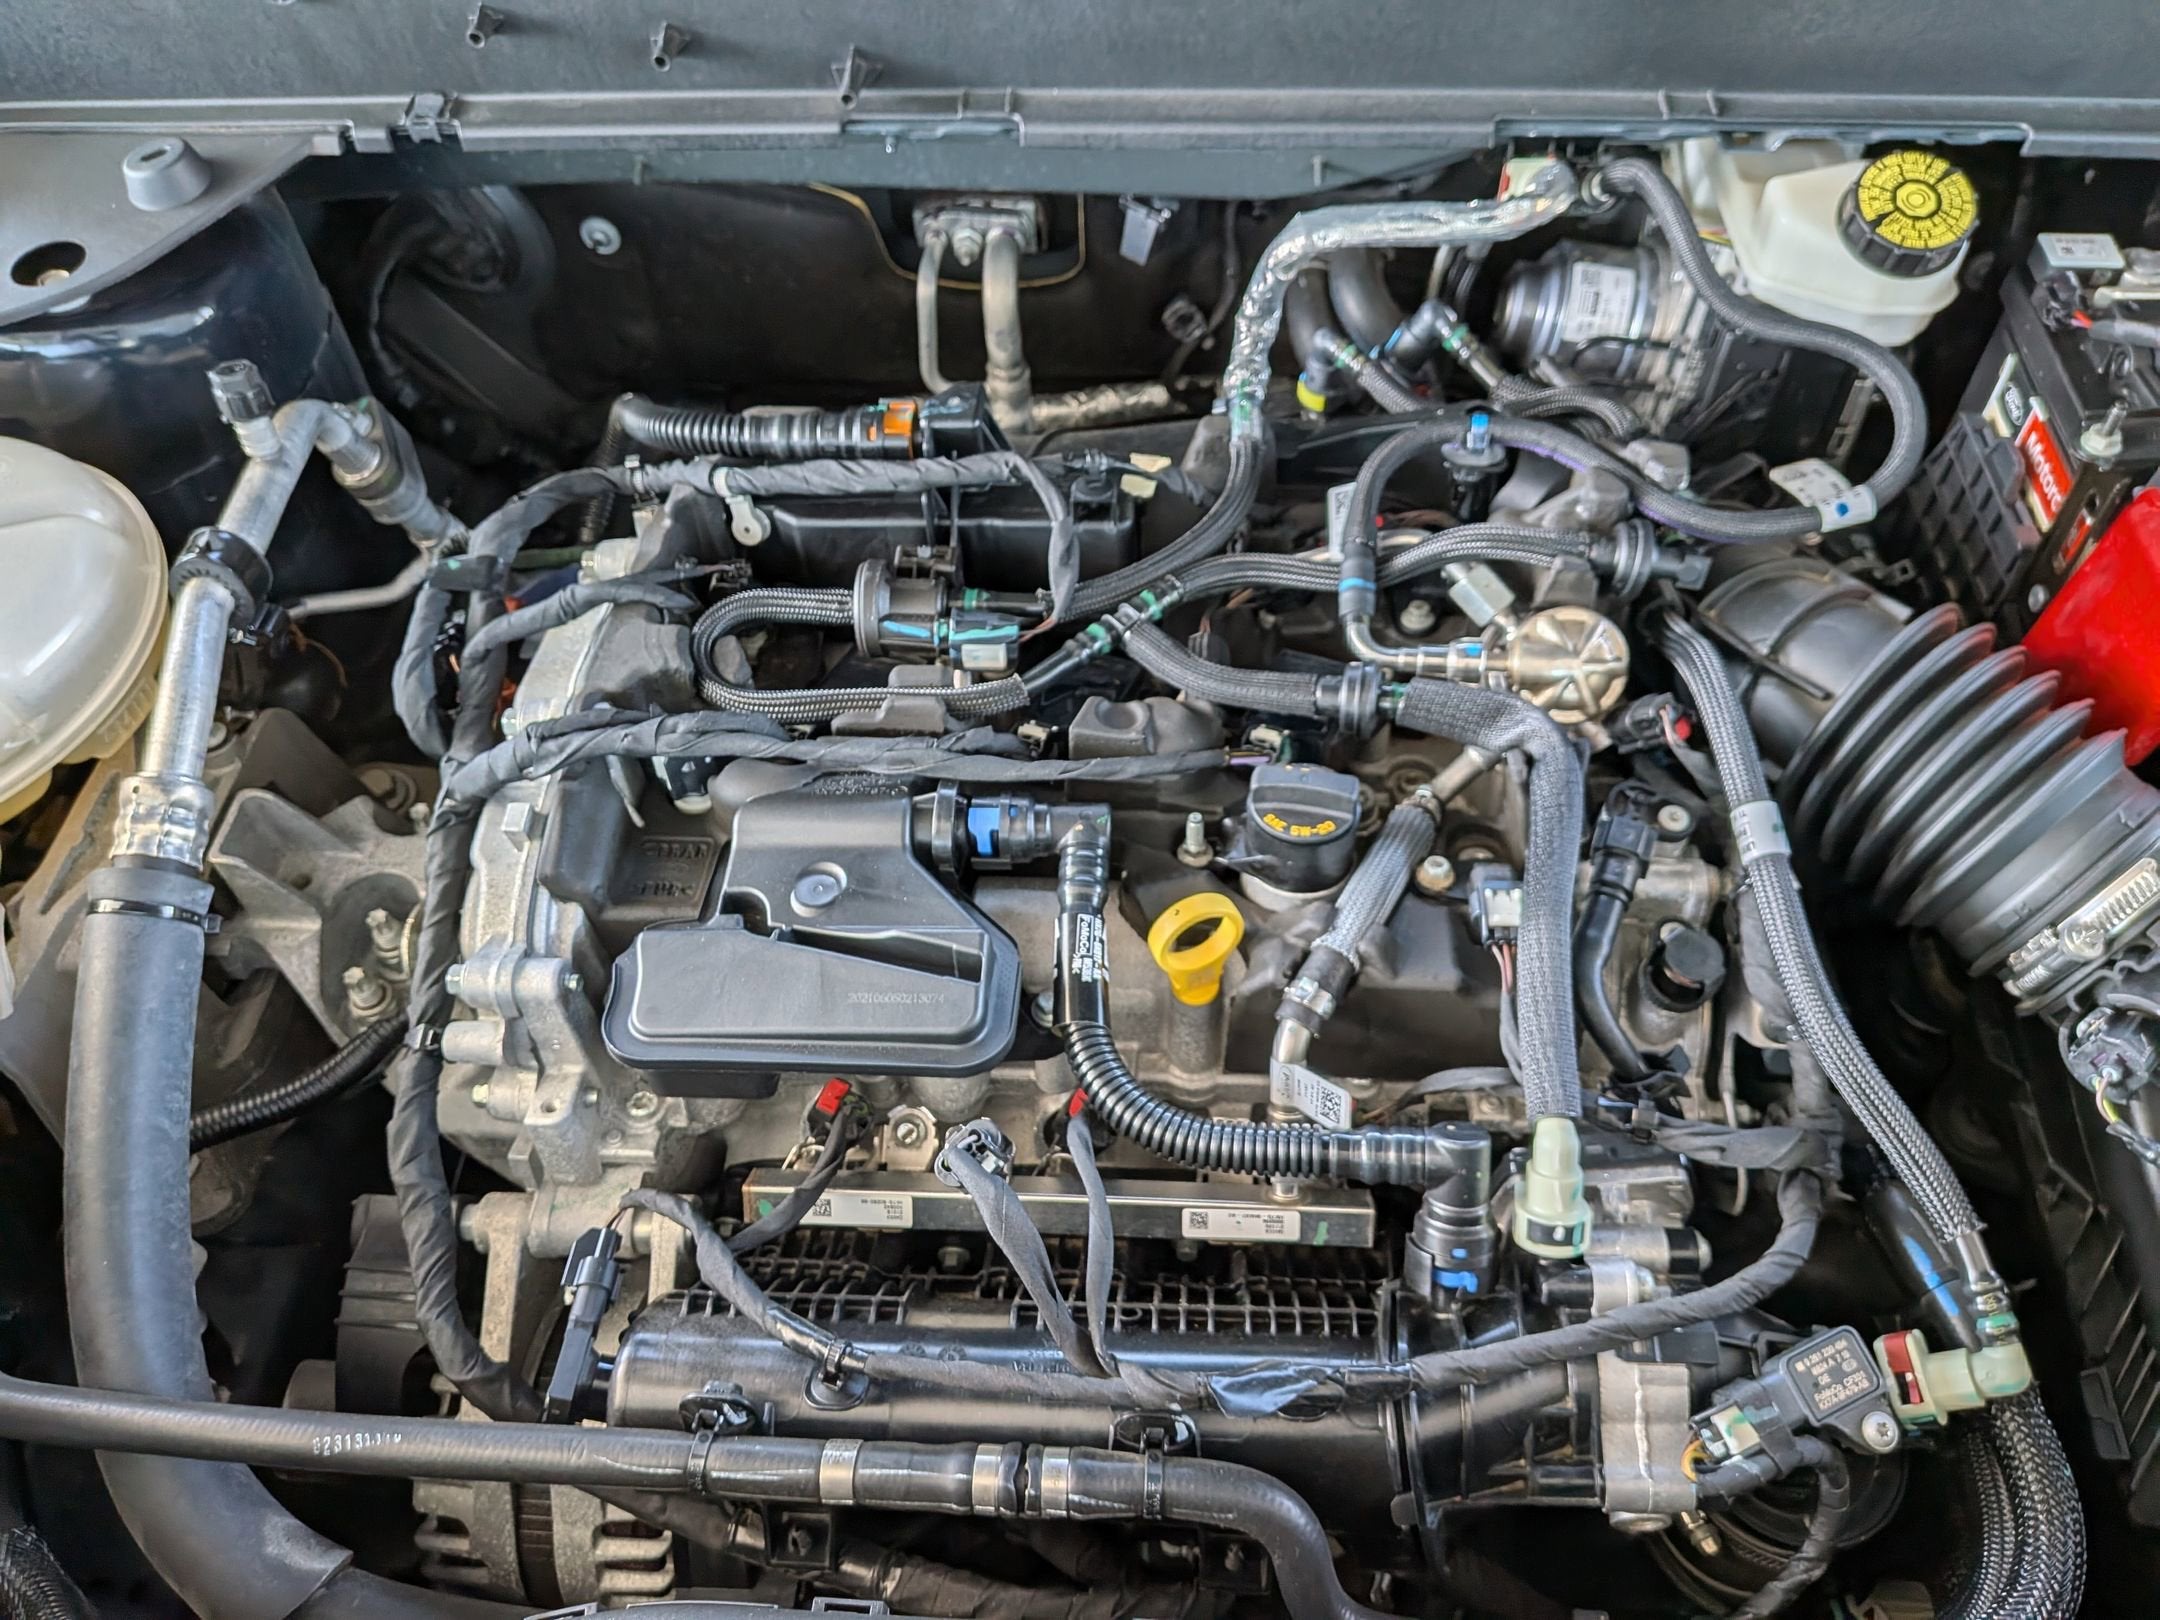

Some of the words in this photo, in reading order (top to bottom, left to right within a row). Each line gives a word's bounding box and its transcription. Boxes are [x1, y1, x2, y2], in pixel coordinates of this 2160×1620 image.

[2025, 431, 2062, 512] Motorc
[1263, 812, 1288, 832] SAE
[1289, 819, 1337, 838] 5W-20
[1079, 915, 1091, 953] FoMoCo
